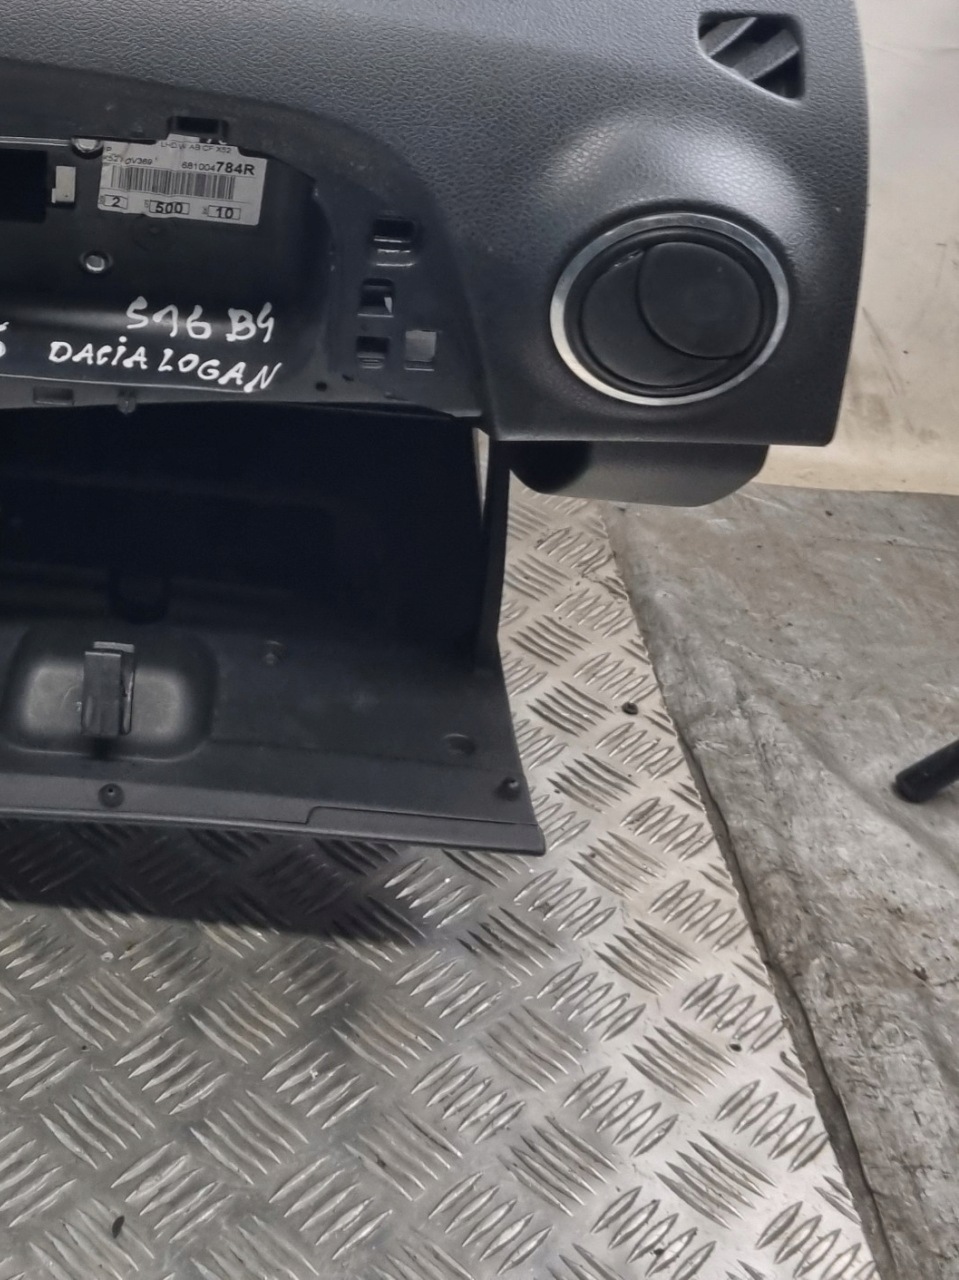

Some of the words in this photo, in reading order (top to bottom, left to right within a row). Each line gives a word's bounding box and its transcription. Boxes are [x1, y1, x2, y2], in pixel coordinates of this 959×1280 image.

[112, 197, 121, 208] 2
[155, 202, 184, 214] 500
[216, 207, 234, 219] 10
[158, 348, 283, 393] LOGAN
